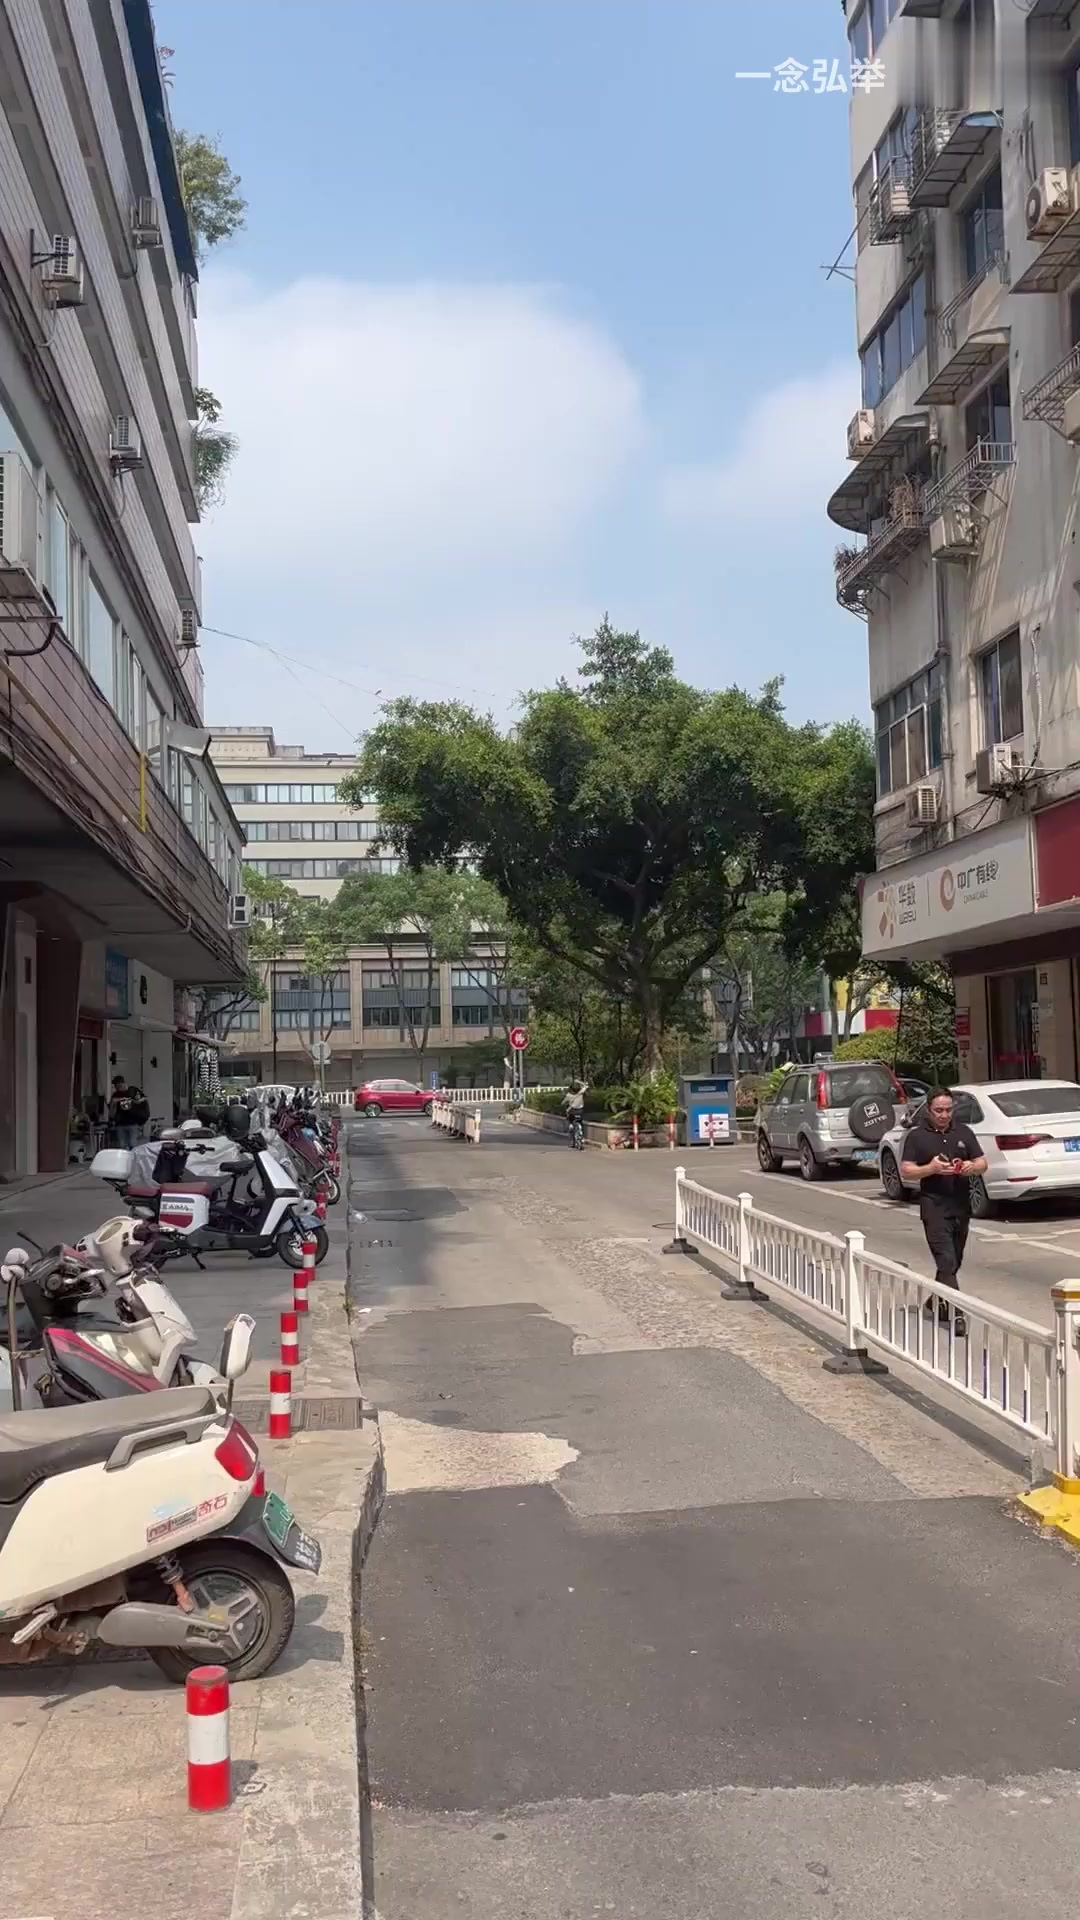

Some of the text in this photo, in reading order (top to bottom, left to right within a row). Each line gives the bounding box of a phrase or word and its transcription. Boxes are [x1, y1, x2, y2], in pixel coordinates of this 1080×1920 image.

[957, 860, 999, 889] 中广有线
[199, 1494, 228, 1516] 奇石
